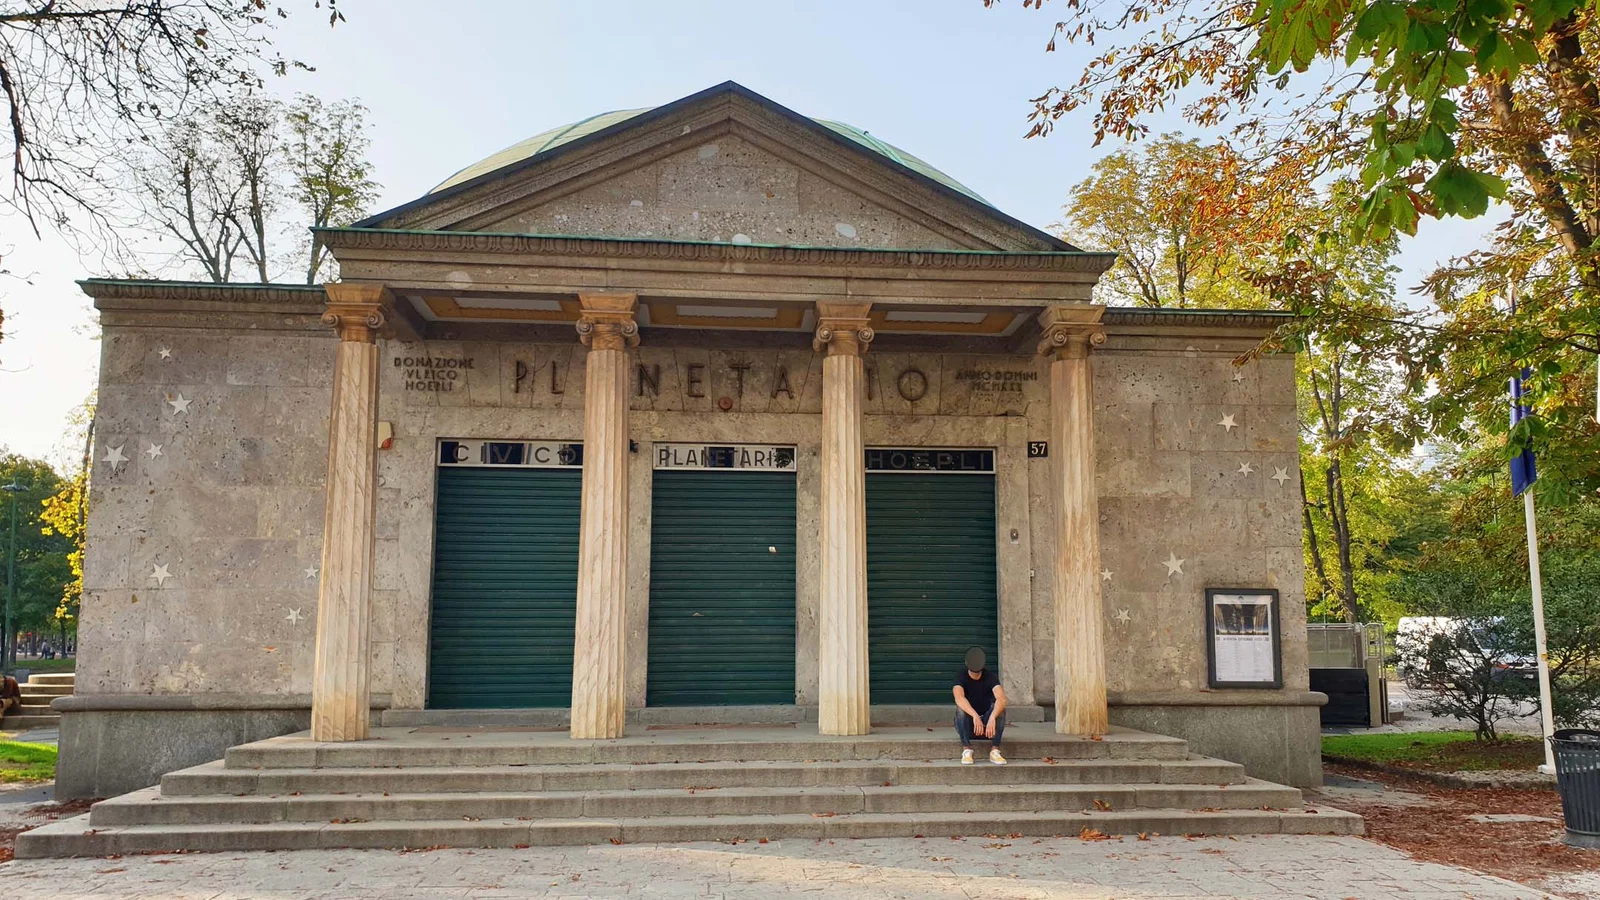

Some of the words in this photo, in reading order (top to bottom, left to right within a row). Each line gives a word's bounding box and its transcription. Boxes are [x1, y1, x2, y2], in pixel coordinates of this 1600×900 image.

[393, 357, 475, 369] DONAZIONE
[405, 381, 453, 391] HOEPLI
[514, 360, 928, 401] PLNETAIO
[453, 444, 577, 464] CIVICO
[1031, 443, 1046, 456] 57
[868, 452, 986, 470] HOEPLI
